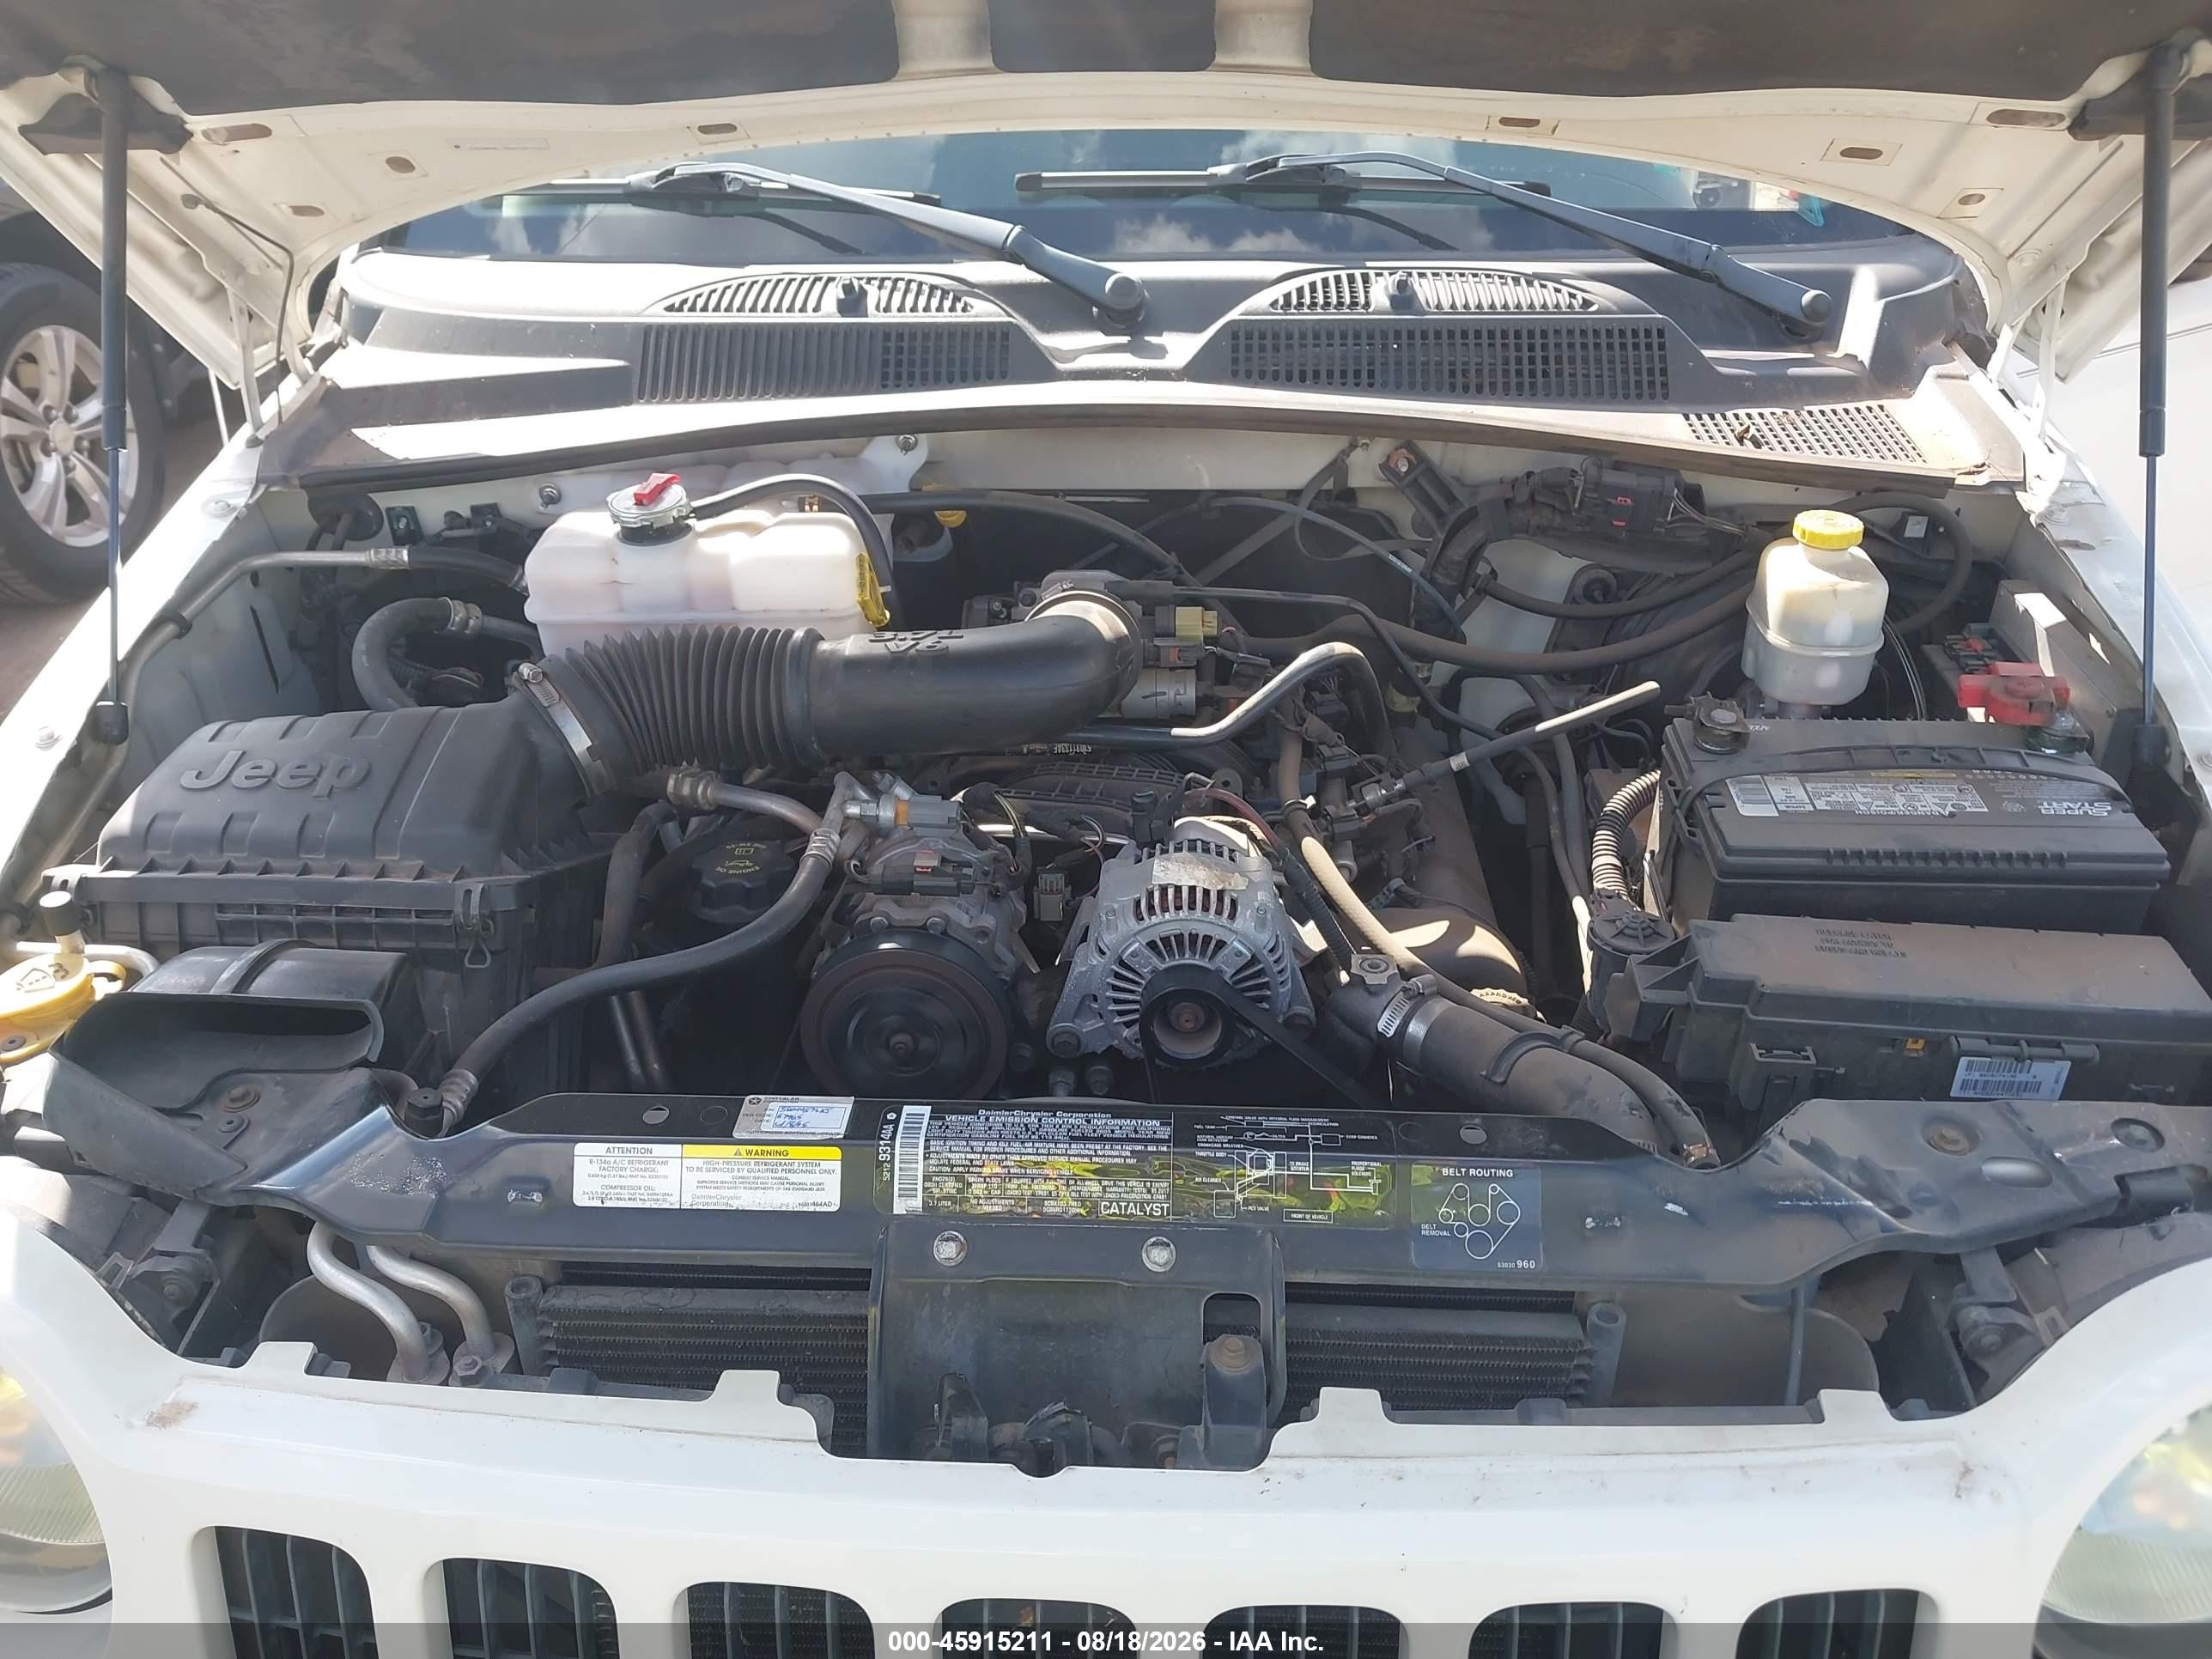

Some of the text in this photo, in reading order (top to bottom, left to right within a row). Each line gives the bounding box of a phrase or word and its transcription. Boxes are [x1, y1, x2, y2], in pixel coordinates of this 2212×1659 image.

[884, 641, 950, 653] V6
[179, 750, 372, 799] Jeep
[2038, 801, 2112, 811] START
[2040, 808, 2109, 817] SUPER
[878, 1124, 895, 1182] 5212 9314AA
[1443, 1168, 1514, 1177] BELT ROUTING
[1101, 1201, 1170, 1216] CATALYST
[1516, 1260, 1535, 1269] 960
